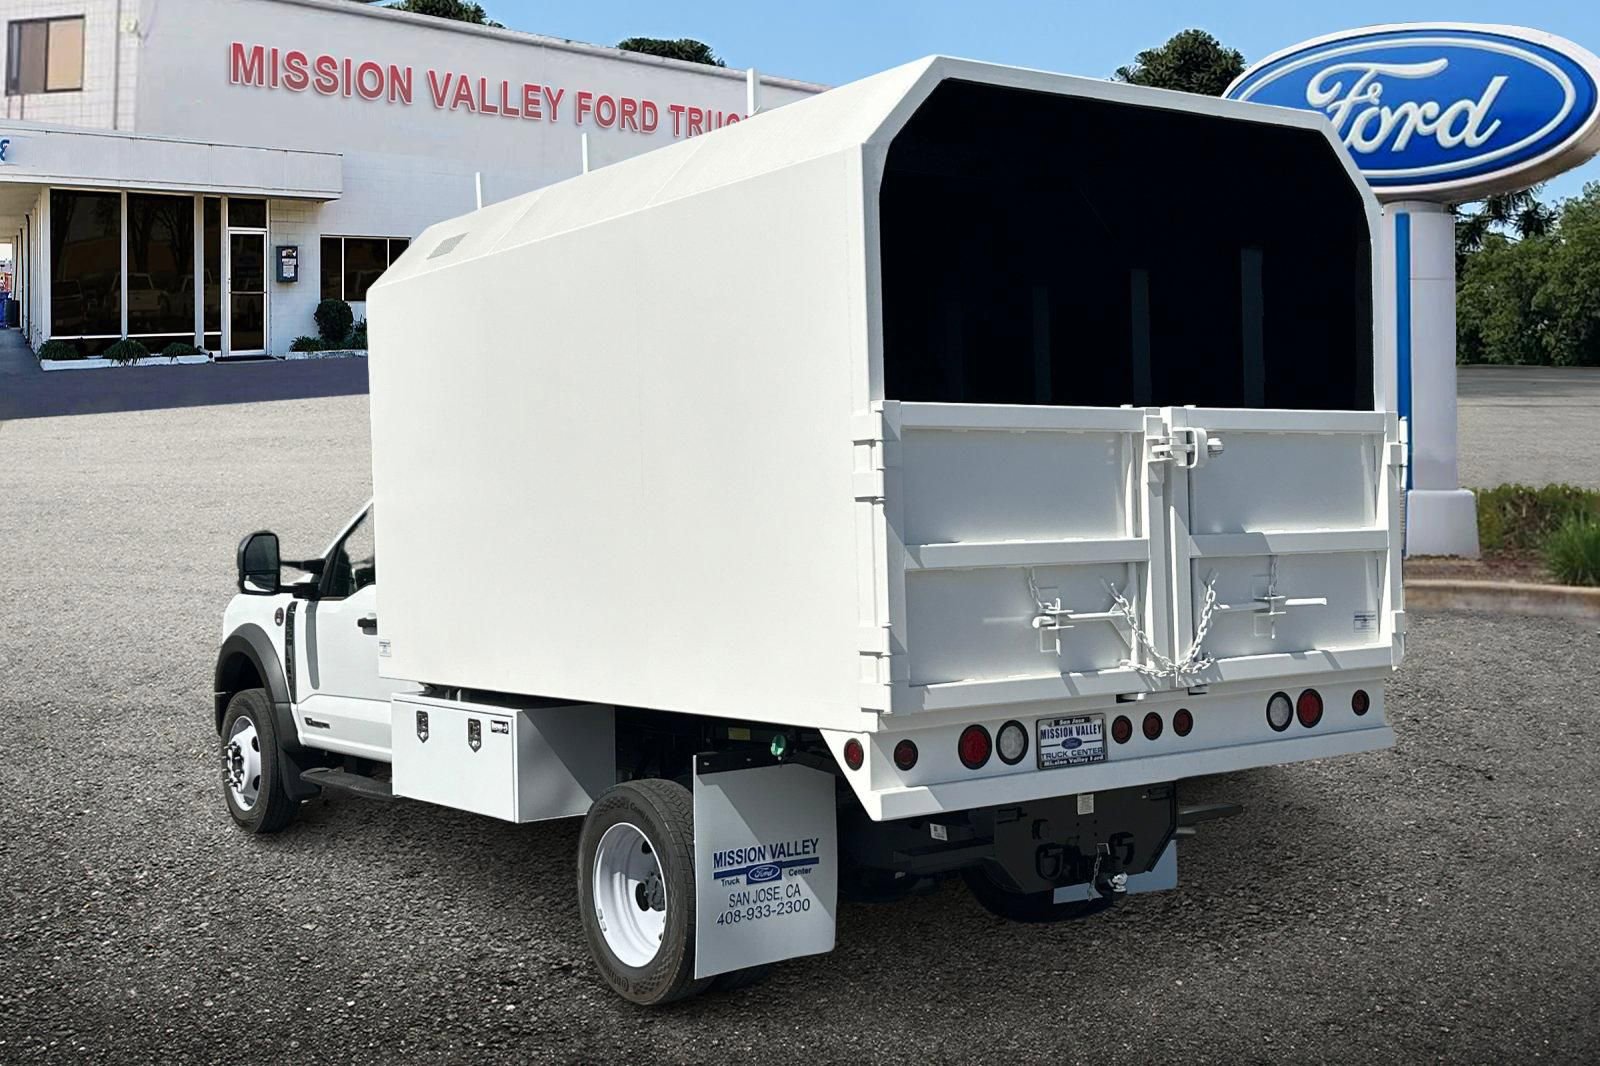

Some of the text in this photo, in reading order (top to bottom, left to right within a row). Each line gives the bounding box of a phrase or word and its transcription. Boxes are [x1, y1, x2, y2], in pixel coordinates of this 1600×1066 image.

[230, 42, 412, 104] MISSION
[426, 69, 564, 121] VALLEY
[576, 91, 659, 133] FORD
[1305, 57, 1509, 154] Ford
[1040, 723, 1102, 740] MISSION VALLEY
[1041, 747, 1103, 760] TRUCK CENTER
[713, 838, 819, 868] MISSION VALLEY
[721, 867, 812, 887] Truck Center
[753, 866, 773, 879] Ford
[729, 883, 801, 908] SAN JOSE, CA
[716, 898, 811, 926] 408-933-2300
